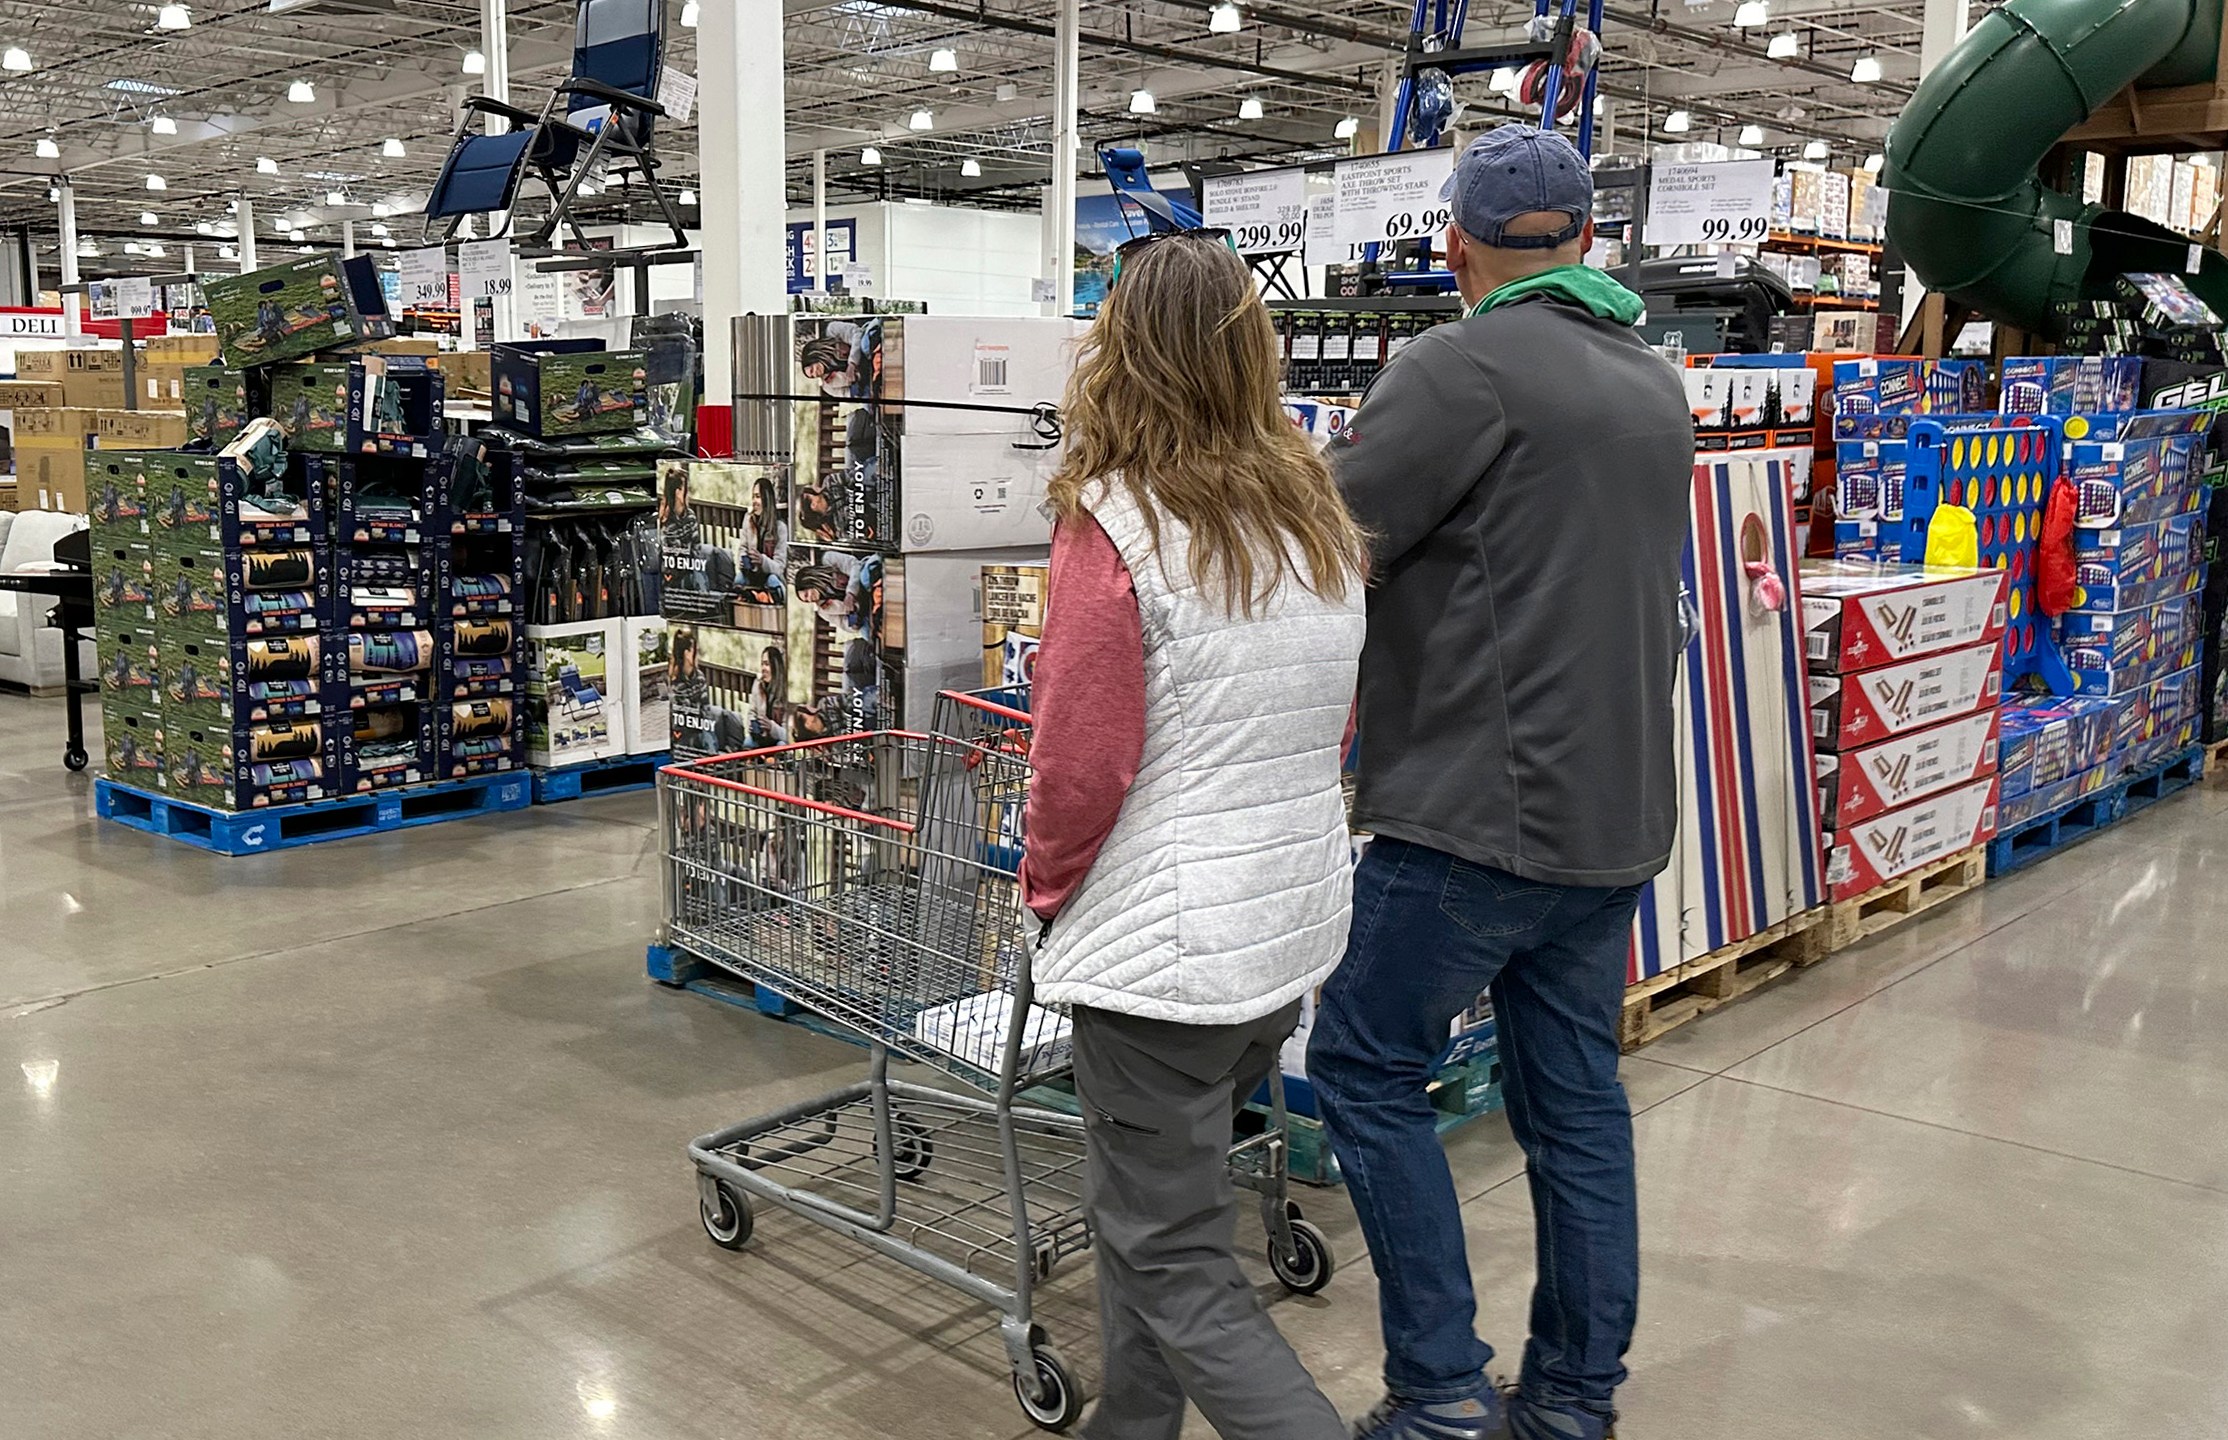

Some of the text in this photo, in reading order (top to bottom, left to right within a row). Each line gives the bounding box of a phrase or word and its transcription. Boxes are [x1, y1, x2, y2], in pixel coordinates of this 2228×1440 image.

[1341, 166, 1412, 181] EASTPOINT SPORTS
[1341, 175, 1401, 189] AXE THROW SET
[1658, 175, 1716, 184] MEDAL SPORTS
[1341, 180, 1429, 197] WITH THROWING STARS
[1385, 208, 1450, 237] 69.99
[1700, 217, 1767, 241] 99.99
[1236, 222, 1302, 249] 299.99
[416, 281, 446, 300] 349.99
[484, 278, 512, 295] 18.99
[12, 318, 57, 334] DELI
[854, 461, 865, 539] TO ENJOY
[662, 555, 707, 572] TO ENJOY
[672, 712, 716, 732] TO ENJOY
